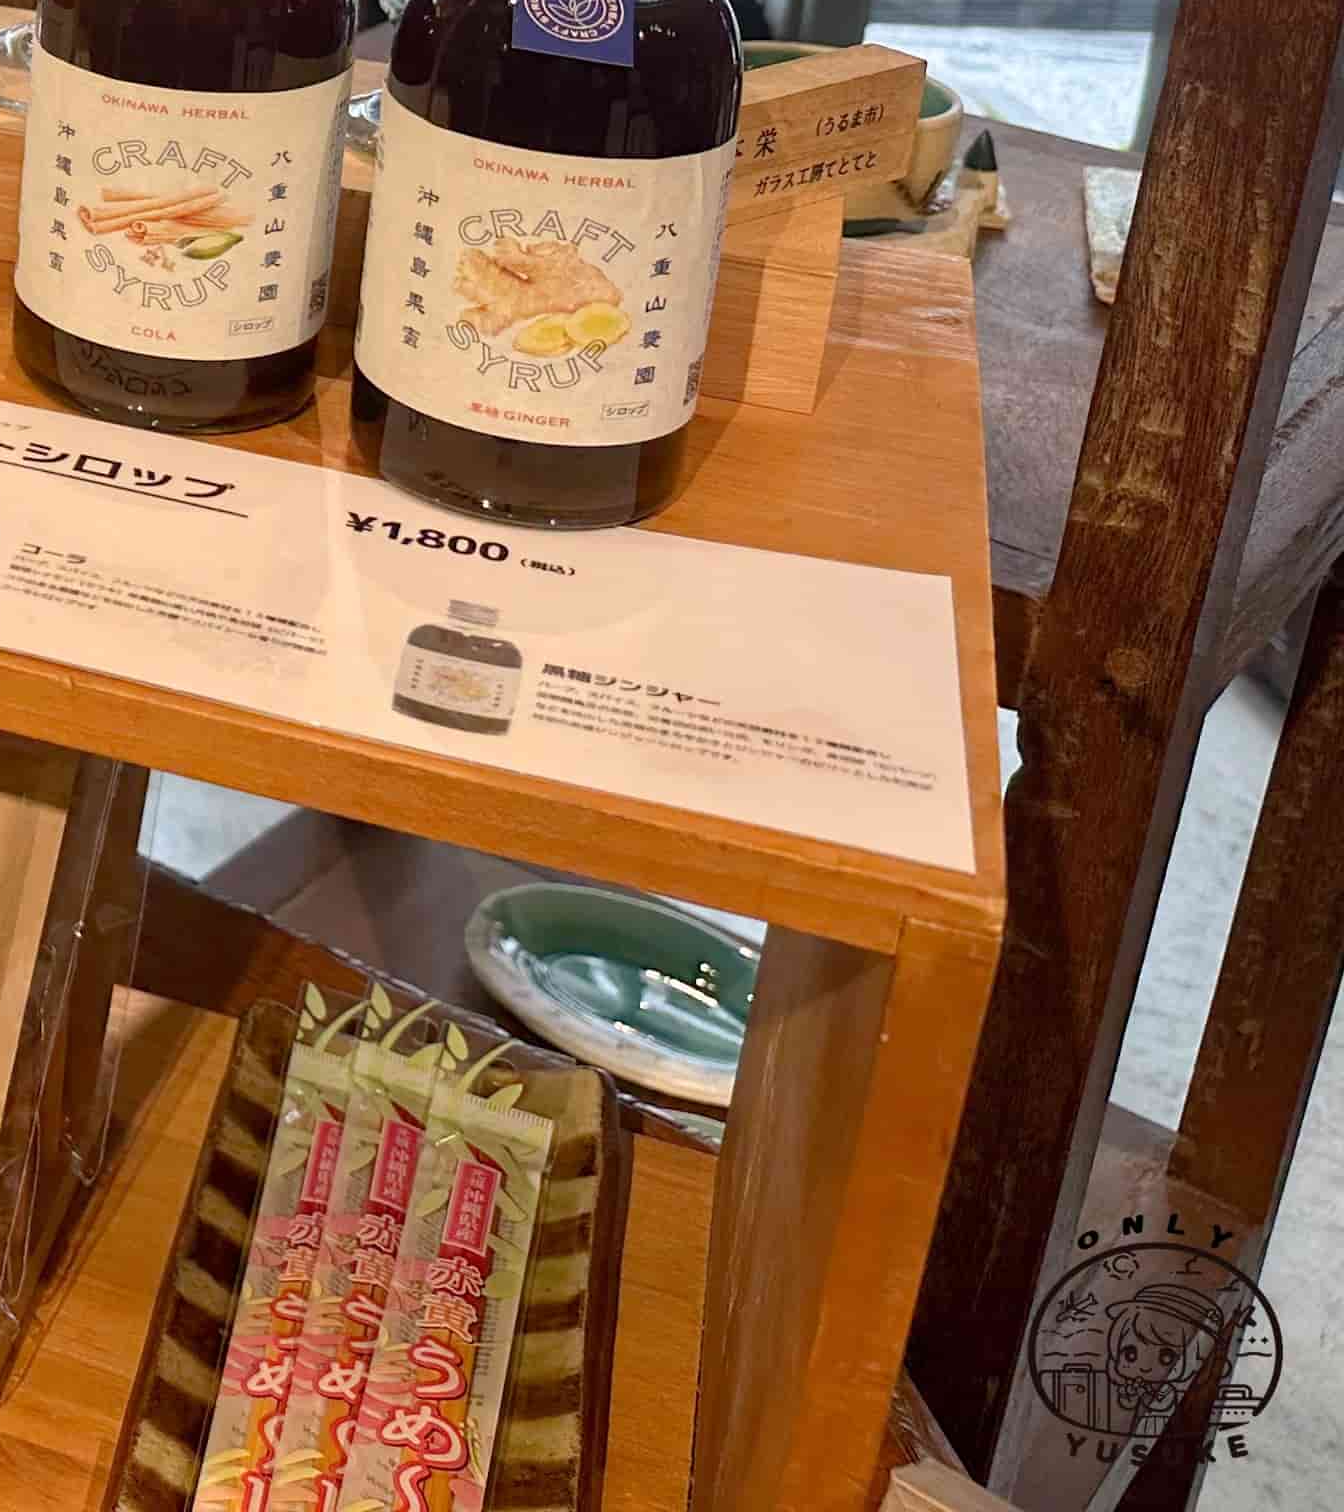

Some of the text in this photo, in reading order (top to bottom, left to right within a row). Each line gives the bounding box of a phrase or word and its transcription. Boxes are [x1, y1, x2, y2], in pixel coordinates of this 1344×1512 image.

[101, 93, 250, 121] OKINAWA HERBAL
[91, 139, 253, 189] CRAFT
[472, 157, 637, 189] OKINAWA HERBAL
[457, 208, 636, 266] CRAFT
[84, 243, 232, 311] SYRUP
[130, 325, 178, 342] COLA
[444, 318, 608, 393] SYRUP
[21, 543, 87, 565] コーラ
[345, 511, 510, 564] ¥1,800
[541, 662, 722, 707] 黒糖ジンジャー
